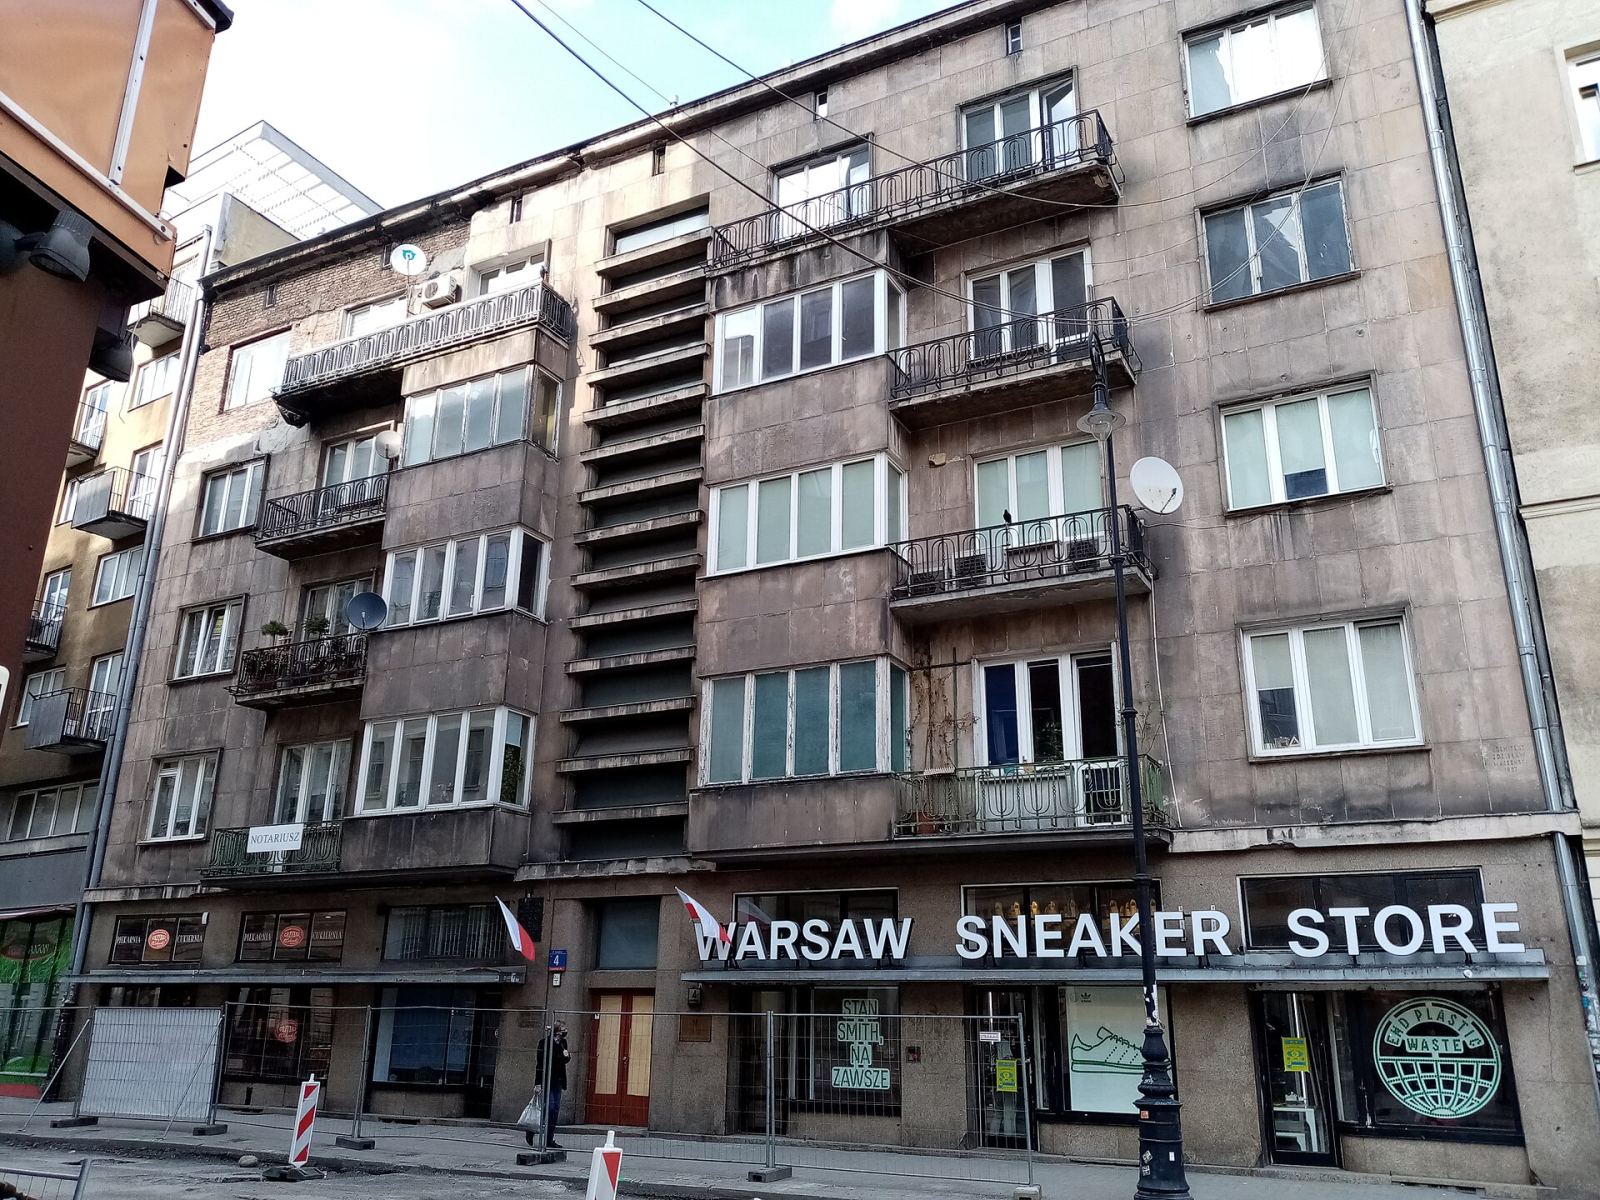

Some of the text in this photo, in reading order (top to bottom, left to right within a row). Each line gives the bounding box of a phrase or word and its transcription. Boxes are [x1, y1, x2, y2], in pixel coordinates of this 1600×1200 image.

[250, 832, 300, 844] NOTARIUSZ
[243, 932, 272, 942] PIEKARNIA
[694, 902, 1526, 962] WARSAW SNEAKER STORE
[553, 955, 560, 966] 4
[843, 1000, 877, 1017] STAN
[838, 1022, 883, 1044] SMITH,
[1386, 1009, 1482, 1046] END PLASTIC
[1406, 1038, 1462, 1052] WASTE
[852, 1046, 871, 1065] NA
[833, 1068, 889, 1088] ZAWSZE
